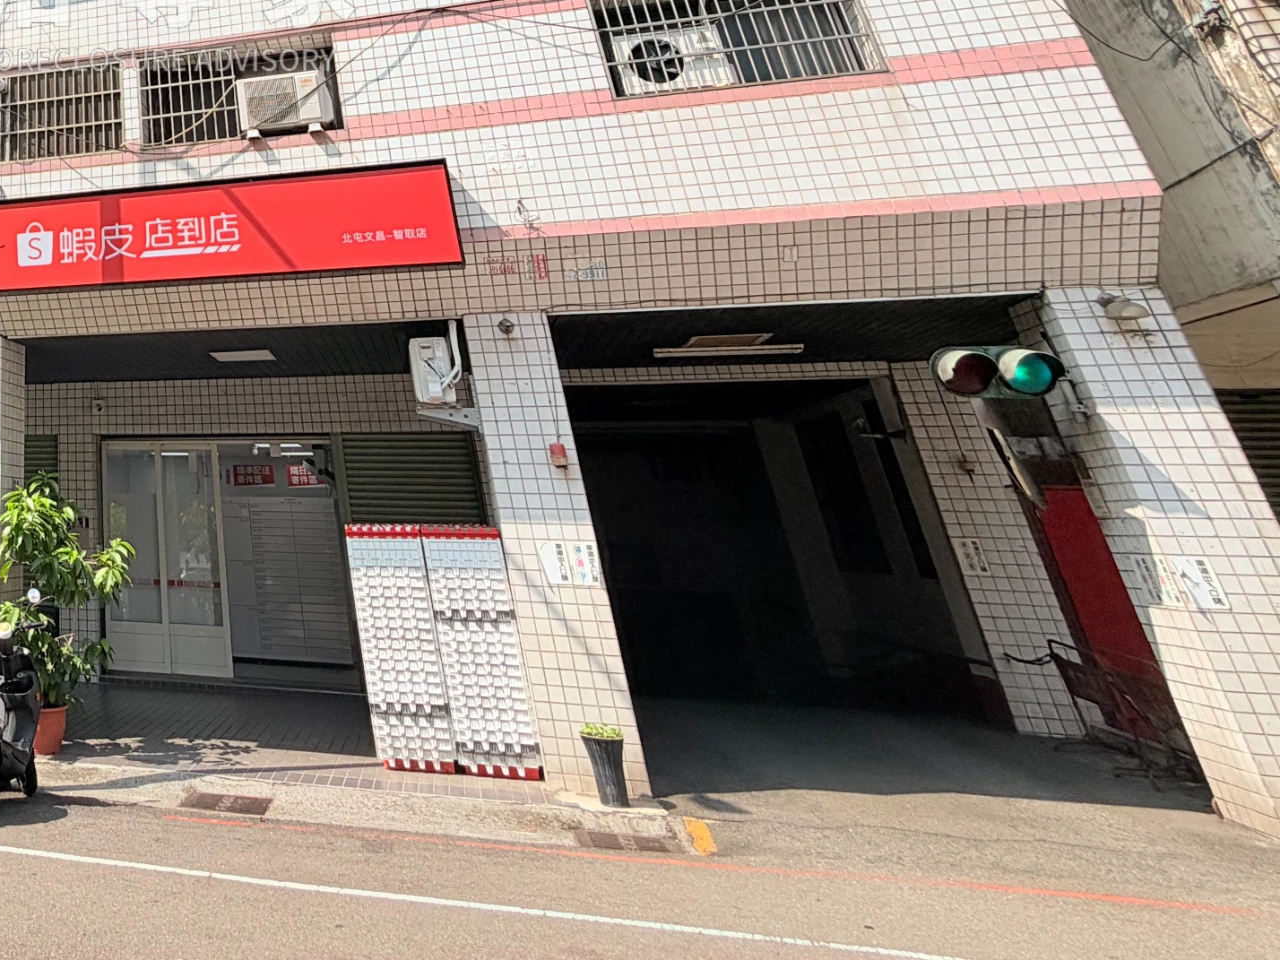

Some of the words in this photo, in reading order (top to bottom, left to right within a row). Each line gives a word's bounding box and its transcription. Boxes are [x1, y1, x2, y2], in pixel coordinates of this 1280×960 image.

[59, 222, 137, 264] 蝦皮
[144, 211, 241, 248] 店到店
